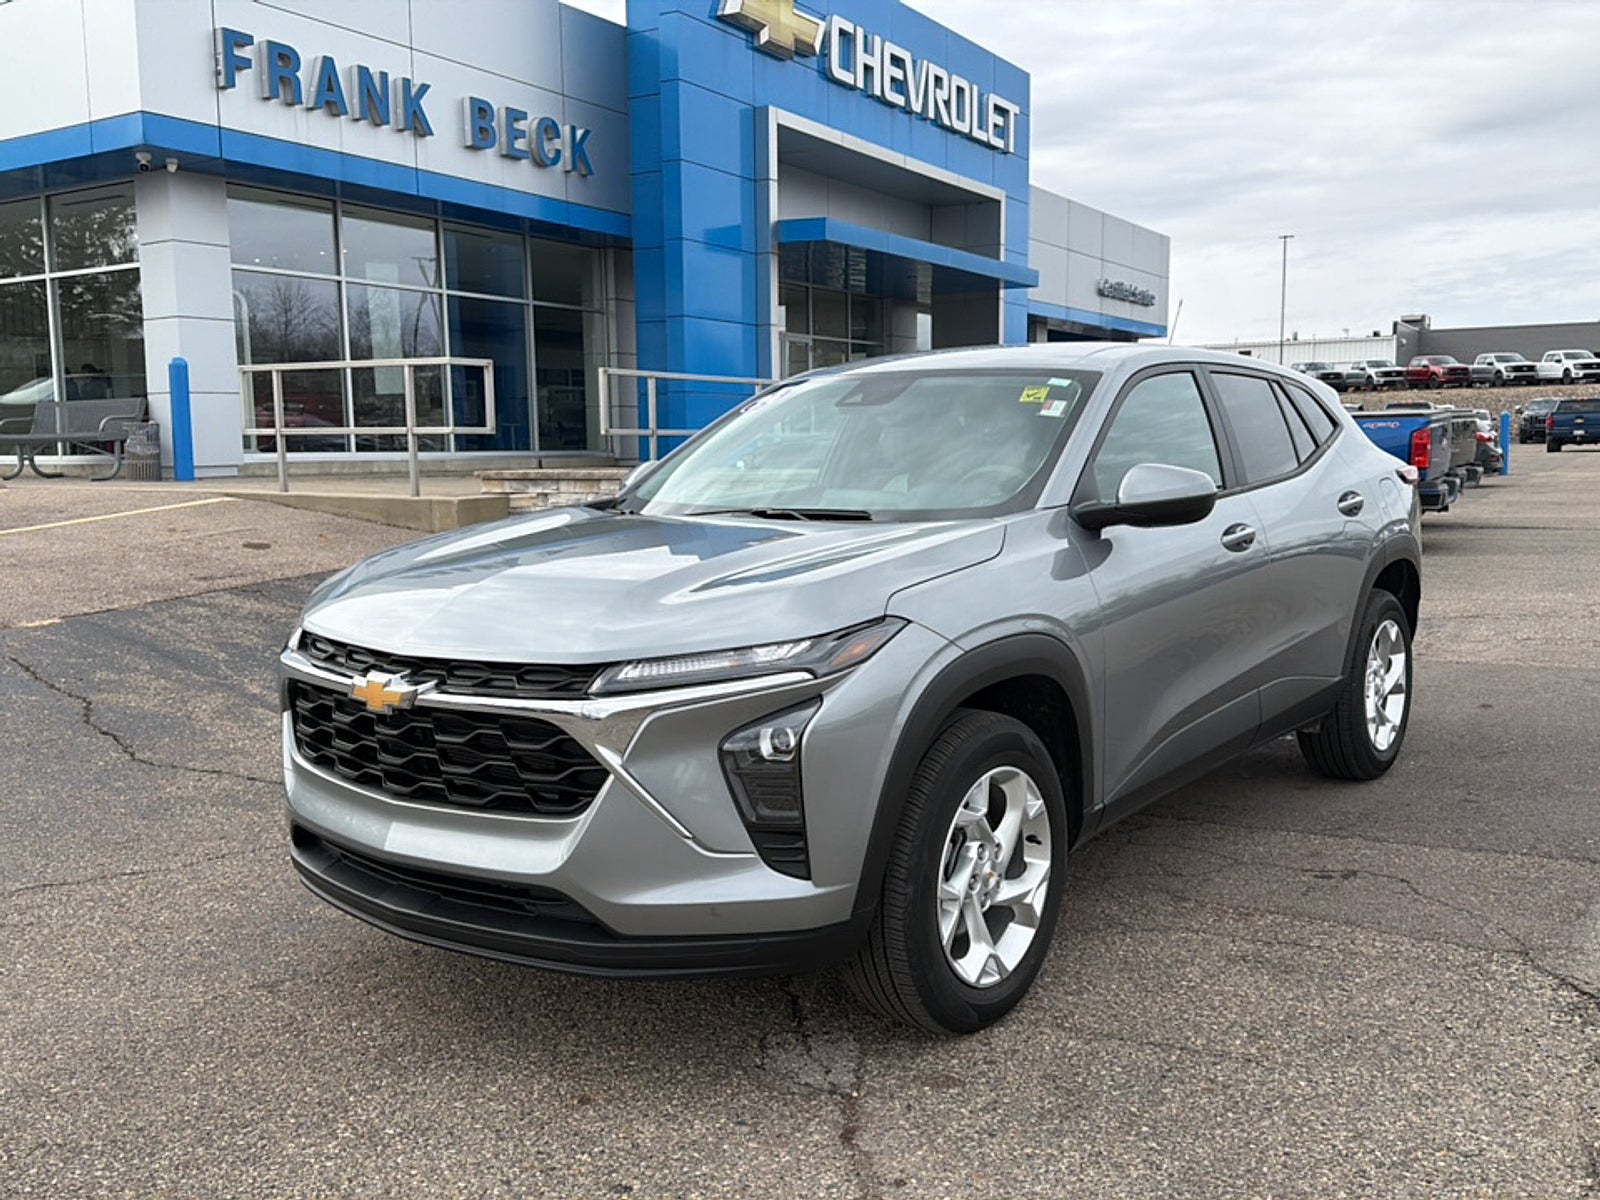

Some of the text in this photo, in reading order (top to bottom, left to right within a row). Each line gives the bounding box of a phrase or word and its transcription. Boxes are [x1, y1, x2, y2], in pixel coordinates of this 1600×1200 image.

[215, 27, 595, 176] FRANK BECK
[827, 15, 1020, 153] CHEVROLET
